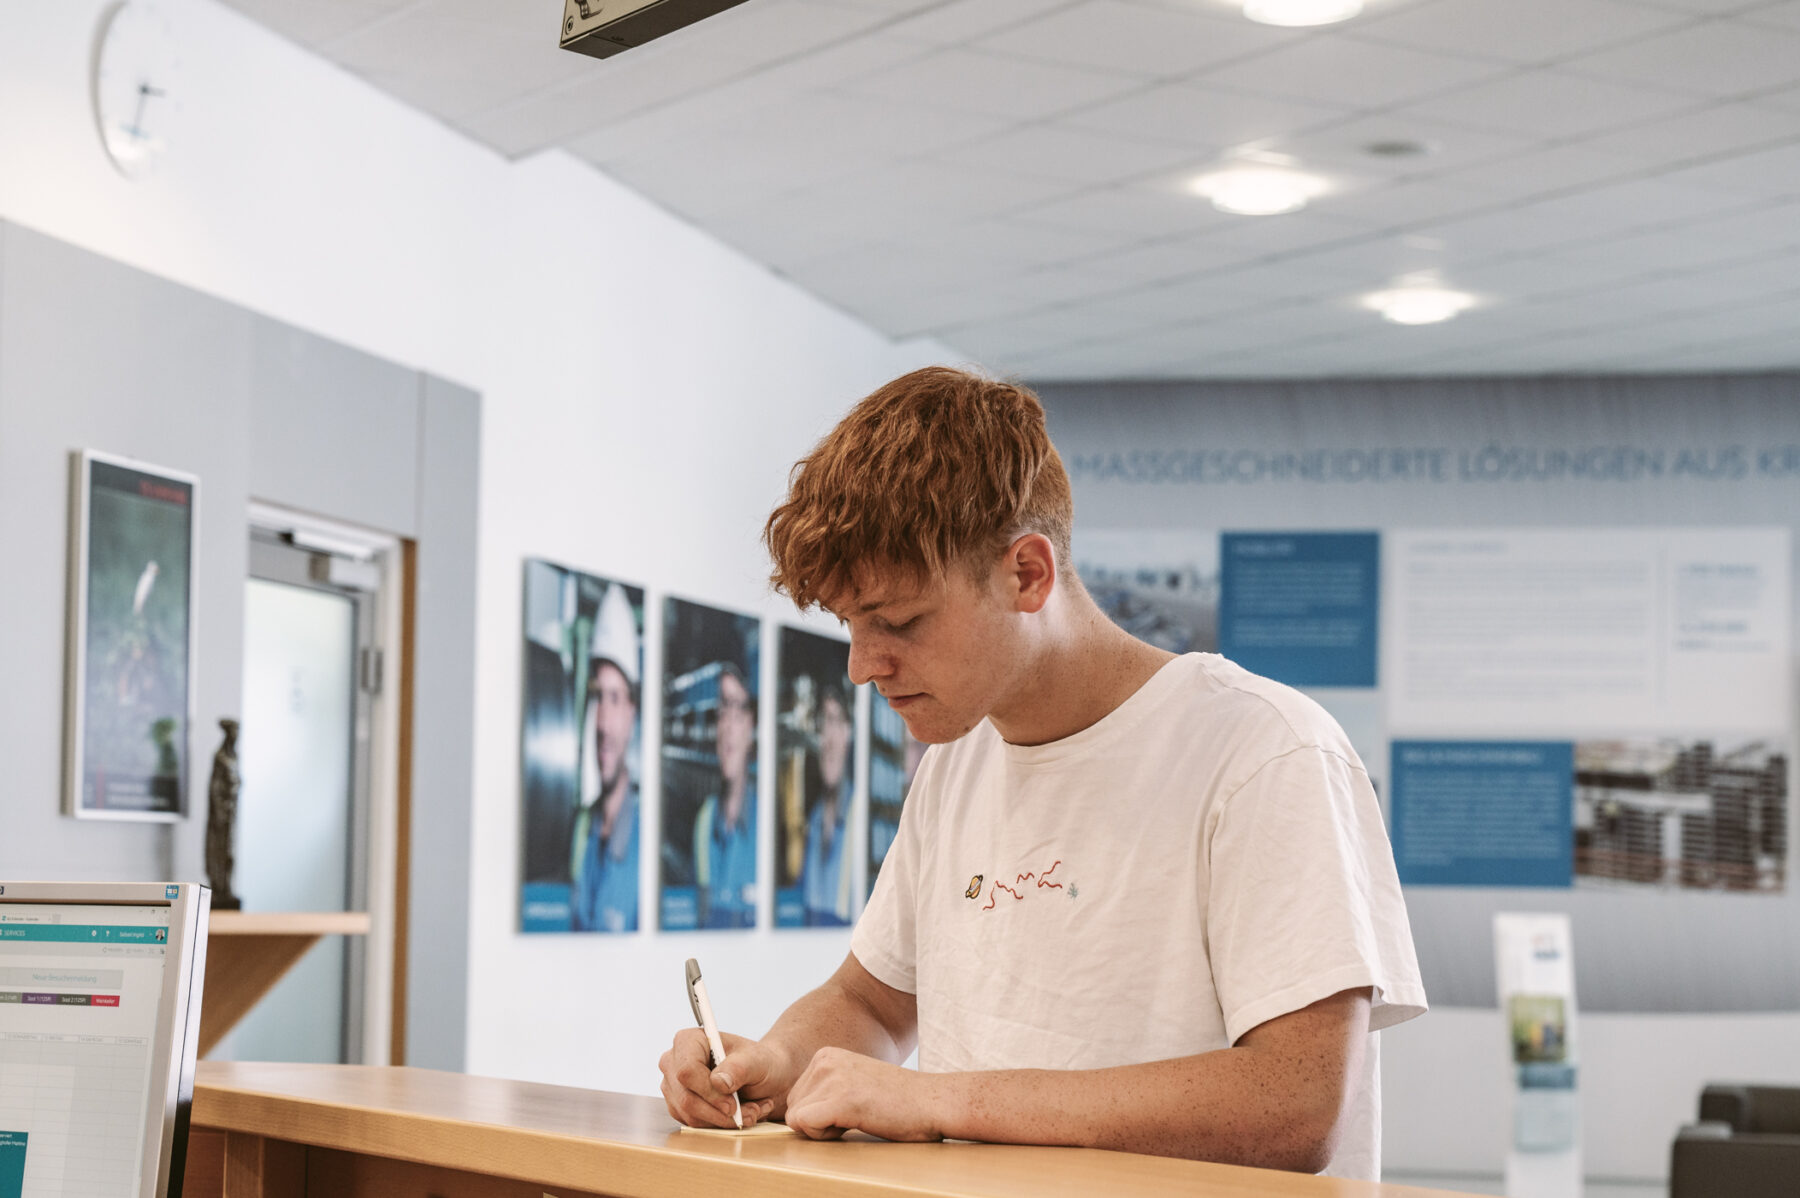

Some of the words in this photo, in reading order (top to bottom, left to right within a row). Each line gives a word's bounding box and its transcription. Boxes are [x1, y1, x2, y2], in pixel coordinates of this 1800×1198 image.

[1071, 448, 1450, 484] MASSGESCHNEIDERTE
[1456, 438, 1664, 483] LÖSUNGEN
[1670, 446, 1751, 482] AUS
